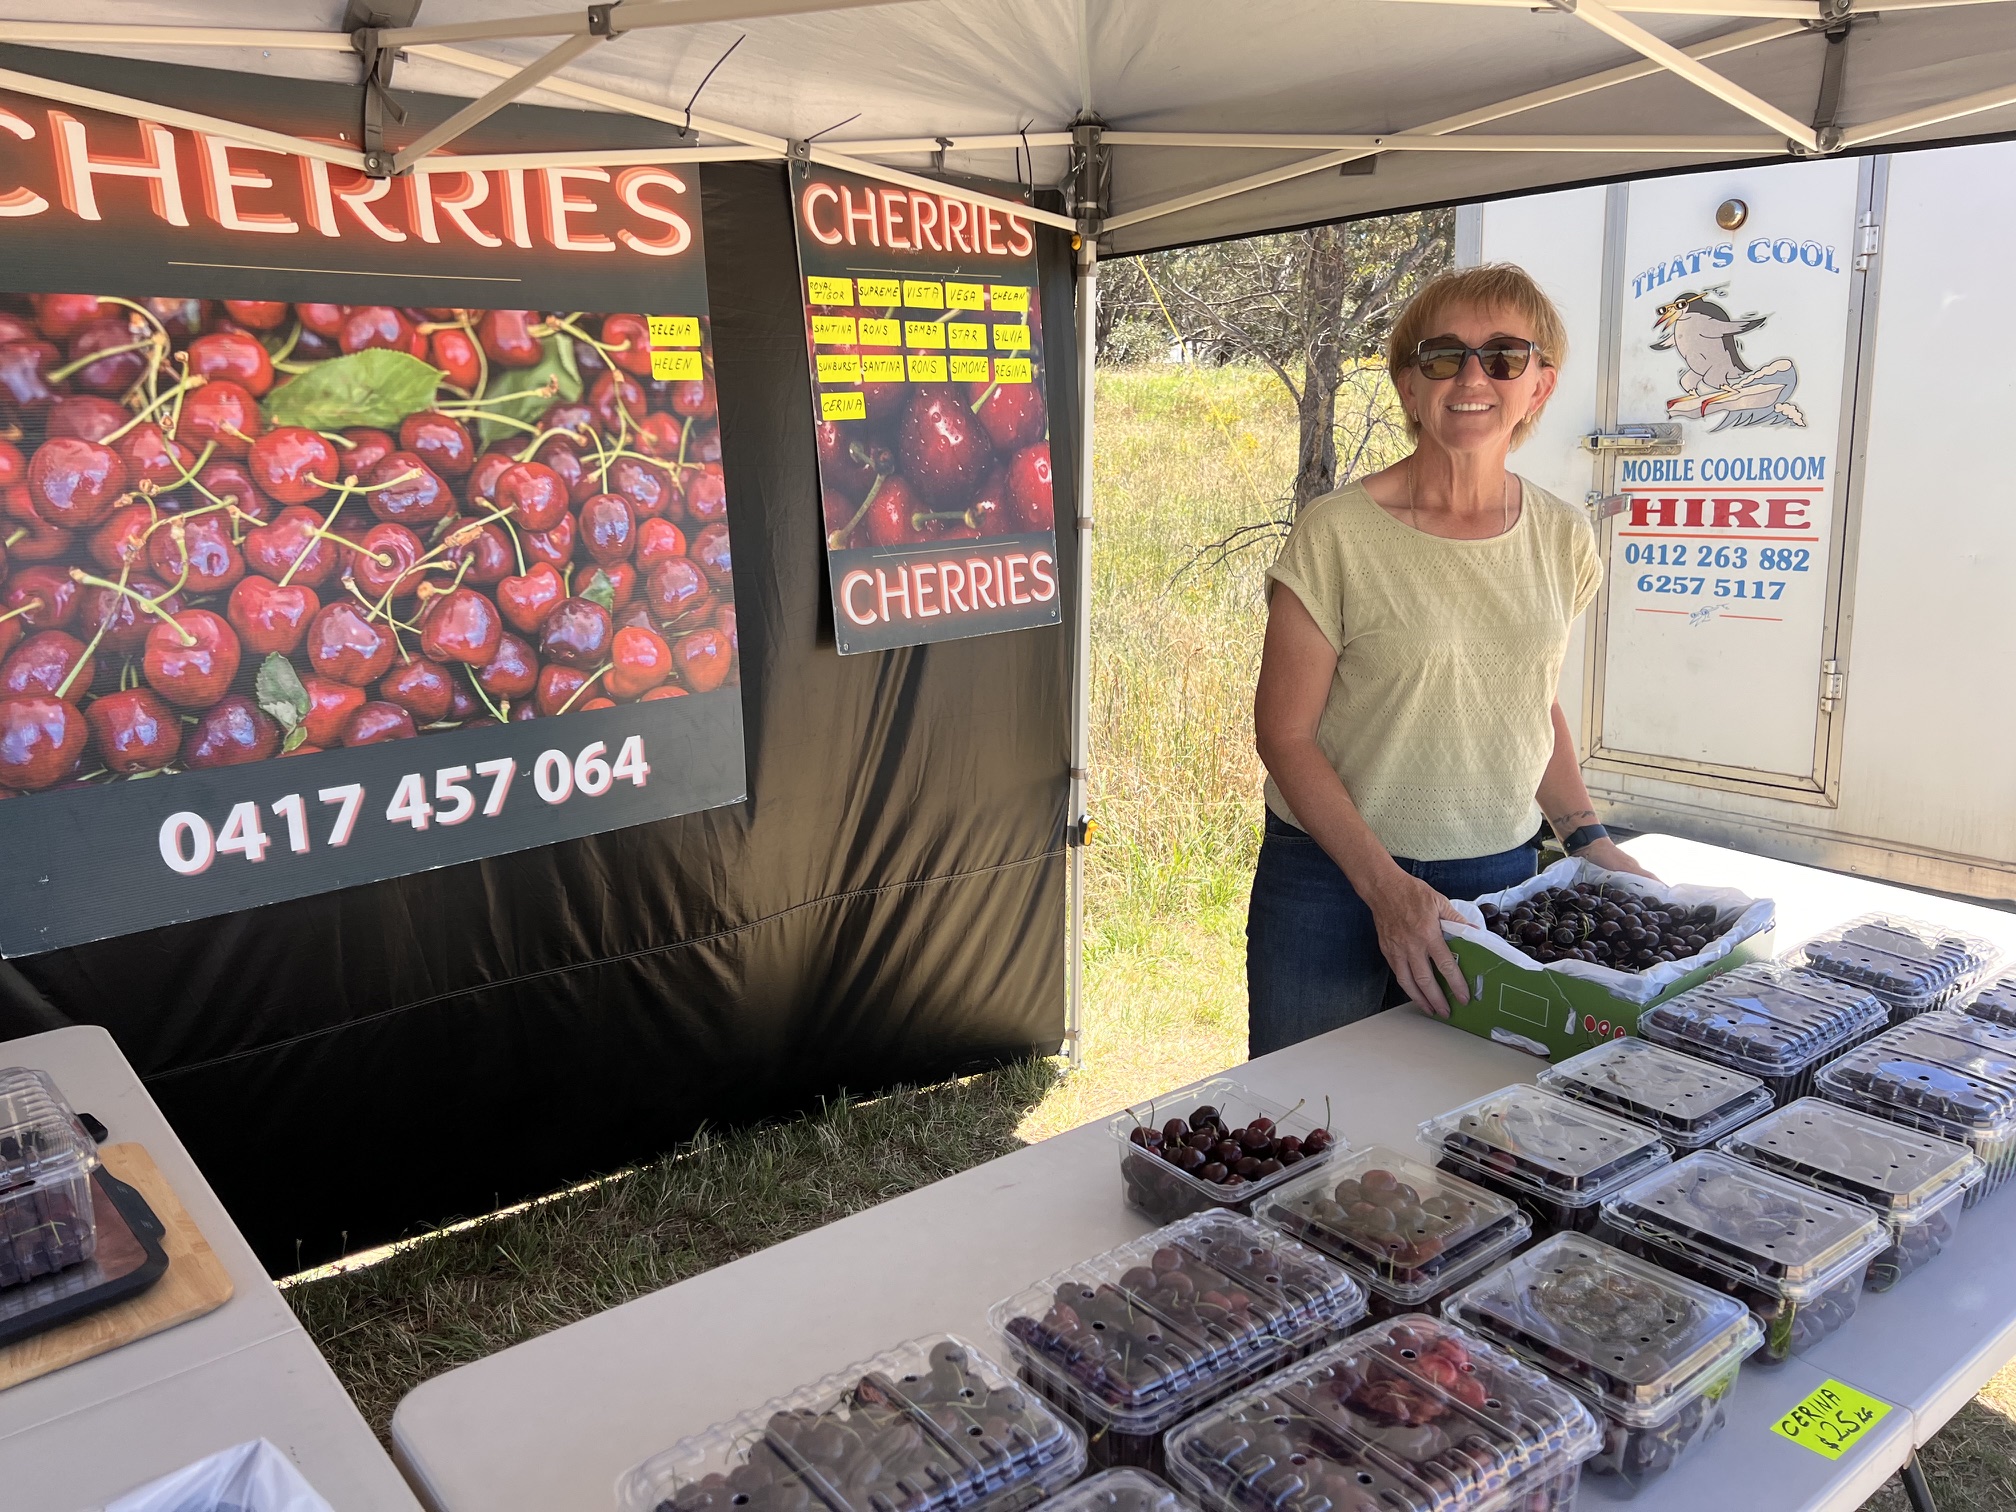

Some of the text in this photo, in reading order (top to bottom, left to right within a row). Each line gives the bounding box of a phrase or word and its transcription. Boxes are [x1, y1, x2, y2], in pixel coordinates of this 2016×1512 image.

[803, 183, 1033, 257] CHERRIES
[1631, 237, 1840, 299] THAT'S COOL
[809, 282, 832, 291] ROYAL
[859, 286, 899, 297] SUPREME
[907, 287, 939, 298] VISTA
[950, 290, 976, 301] VEGA
[993, 291, 1026, 300] CHELAN
[651, 324, 692, 336] JELENA
[814, 325, 852, 334] SANTINA
[863, 324, 888, 335] RONS
[908, 324, 938, 335] SAMBA
[952, 329, 977, 342] STAR
[995, 329, 1023, 342] SILVIA
[654, 358, 693, 371] HELEN
[818, 363, 858, 373] SUNBURST
[863, 360, 901, 373] SANTINA
[911, 360, 937, 374] RONS
[952, 361, 987, 374] SIMONE
[995, 365, 1027, 377] REGINA
[823, 399, 863, 413] CERINA
[1622, 456, 1827, 483] MOBILE COOLROOM
[1628, 498, 1811, 530] HIRE
[1625, 543, 1810, 573] 0412 263 882
[841, 551, 1056, 626] CHERRIES
[1637, 574, 1787, 601] 6257 5117
[158, 735, 650, 876] 0417 457 064
[1782, 1388, 1841, 1437] CERINA
